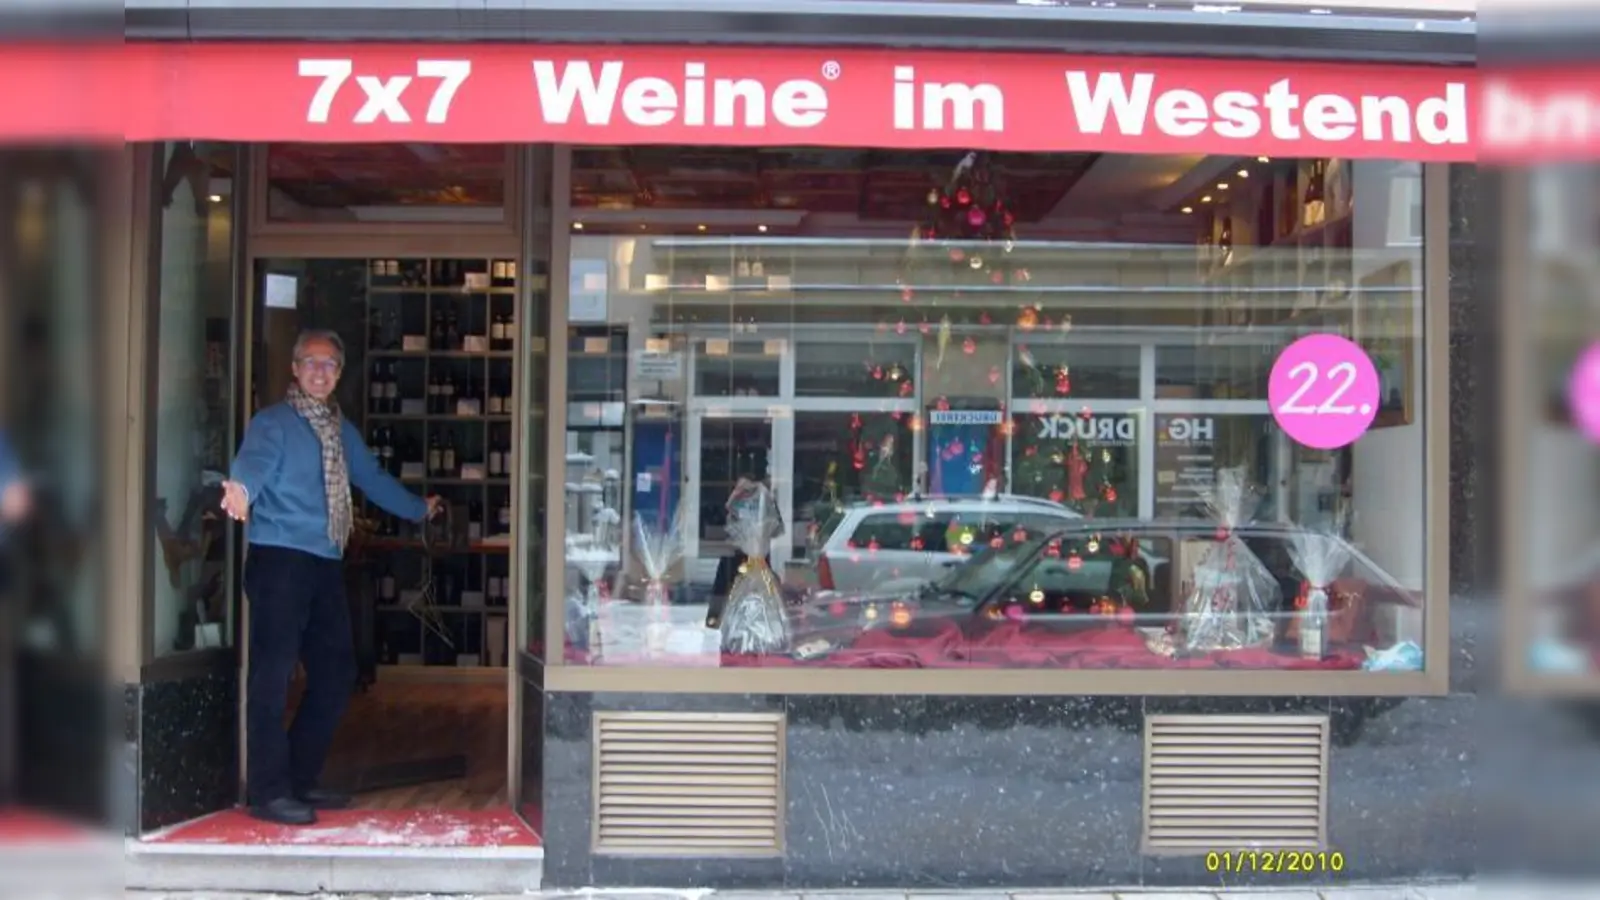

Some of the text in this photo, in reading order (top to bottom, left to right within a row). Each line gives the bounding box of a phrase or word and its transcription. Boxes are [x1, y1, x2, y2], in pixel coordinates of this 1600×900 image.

[298, 58, 472, 124] 7x7
[893, 65, 1005, 132] im
[1065, 71, 1469, 145] Westend
[1277, 360, 1372, 415] 22.
